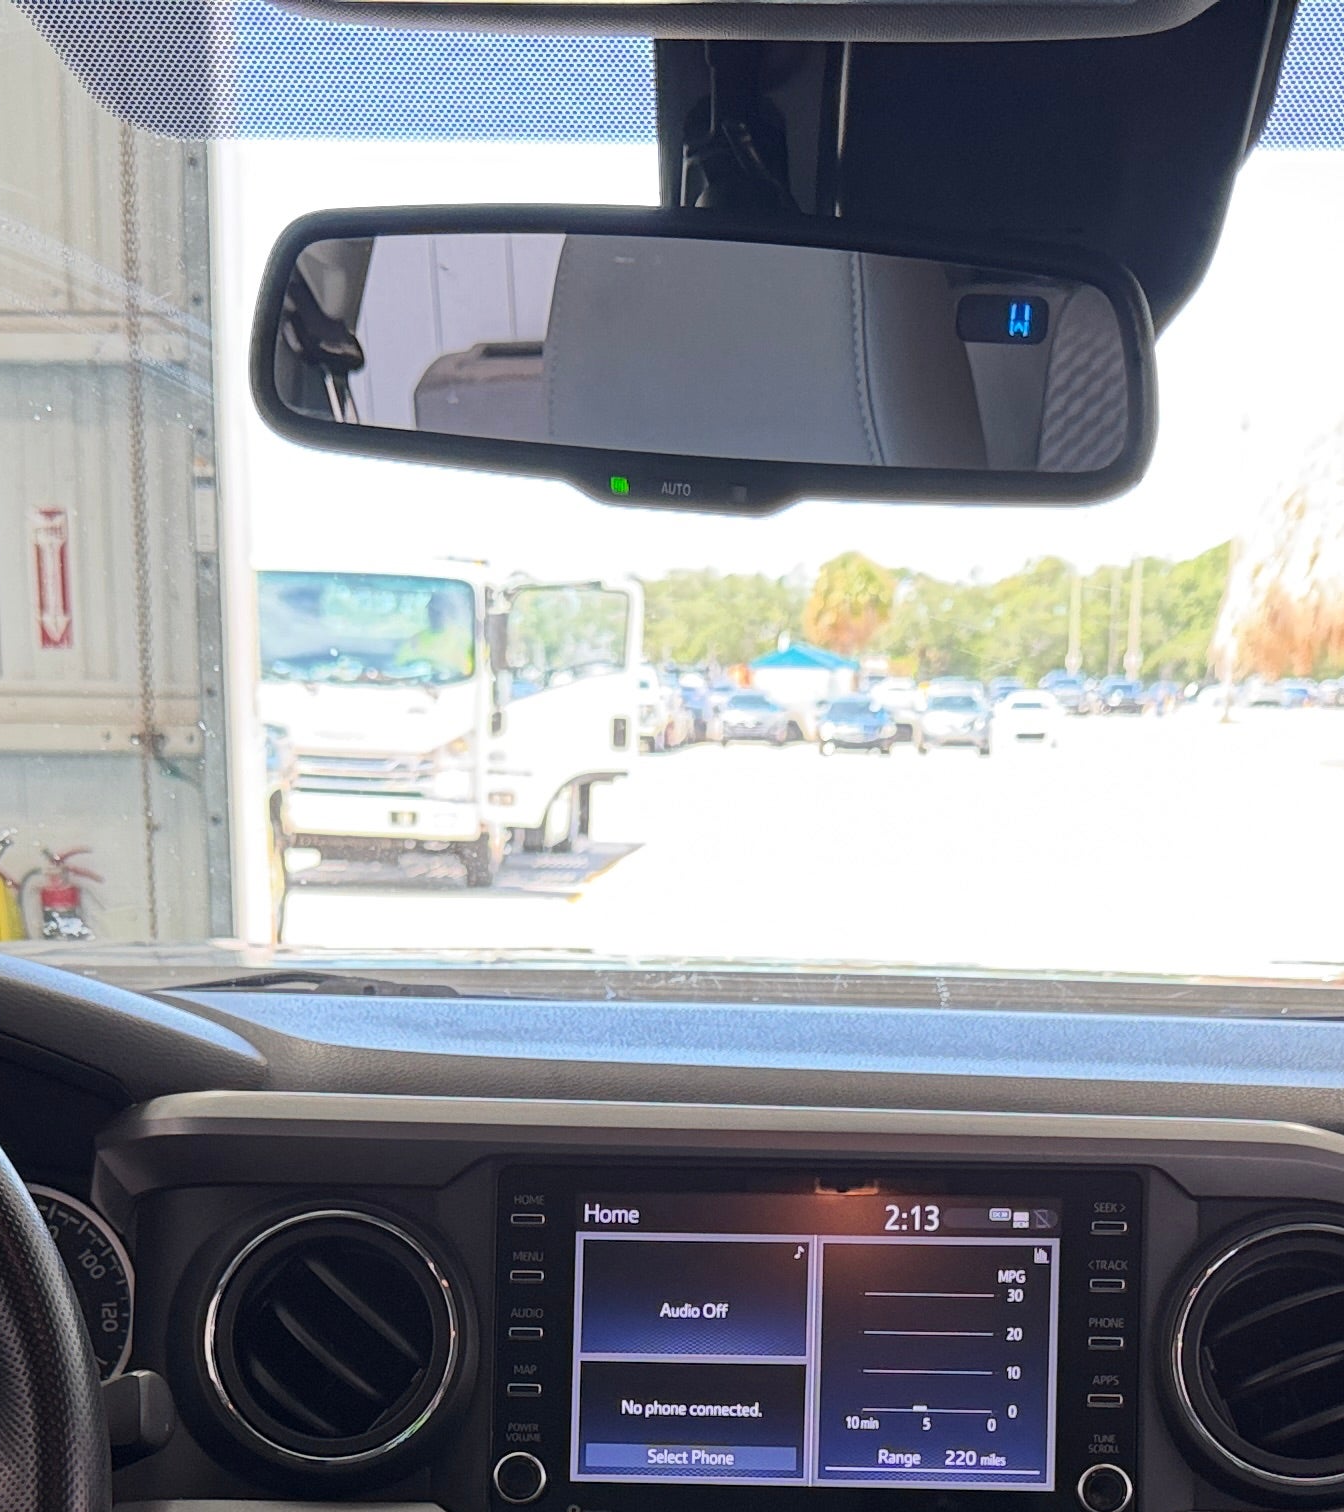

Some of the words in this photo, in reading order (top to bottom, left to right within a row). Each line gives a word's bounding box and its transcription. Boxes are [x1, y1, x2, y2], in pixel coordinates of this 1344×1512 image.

[1009, 303, 1031, 338] W
[661, 481, 692, 497] AUTO
[513, 1194, 545, 1206] HOME
[584, 1203, 641, 1224] Home
[1093, 1202, 1118, 1214] SEEK
[884, 1204, 941, 1231] 2:13
[78, 1247, 106, 1280] 100
[512, 1251, 544, 1262] MENU
[997, 1270, 1027, 1285] MPG
[1006, 1288, 1025, 1303] 30
[100, 1301, 118, 1333] 120
[511, 1307, 545, 1319] AUDIO
[659, 1301, 701, 1319] Audio
[702, 1302, 730, 1320] Off
[1088, 1317, 1125, 1329] PHONE
[1005, 1327, 1024, 1342] 20
[513, 1364, 538, 1376] MAP
[1005, 1366, 1022, 1381] 10
[1091, 1374, 1120, 1386] APPS
[621, 1398, 643, 1416] No
[645, 1400, 687, 1419] phone
[688, 1401, 764, 1418] connected.
[1007, 1404, 1019, 1420] 0
[507, 1421, 540, 1433] POWER
[845, 1416, 860, 1431] 10
[860, 1416, 880, 1431] min
[922, 1416, 932, 1431] 5
[986, 1417, 997, 1432] 0
[505, 1431, 542, 1443] VOLUME
[1092, 1433, 1117, 1444] TUNE
[1088, 1443, 1120, 1455] SCROLL
[647, 1448, 689, 1466] Select
[691, 1448, 735, 1467] Phone
[878, 1448, 922, 1468] Range
[944, 1450, 978, 1467] 220
[979, 1452, 1008, 1468] miles
